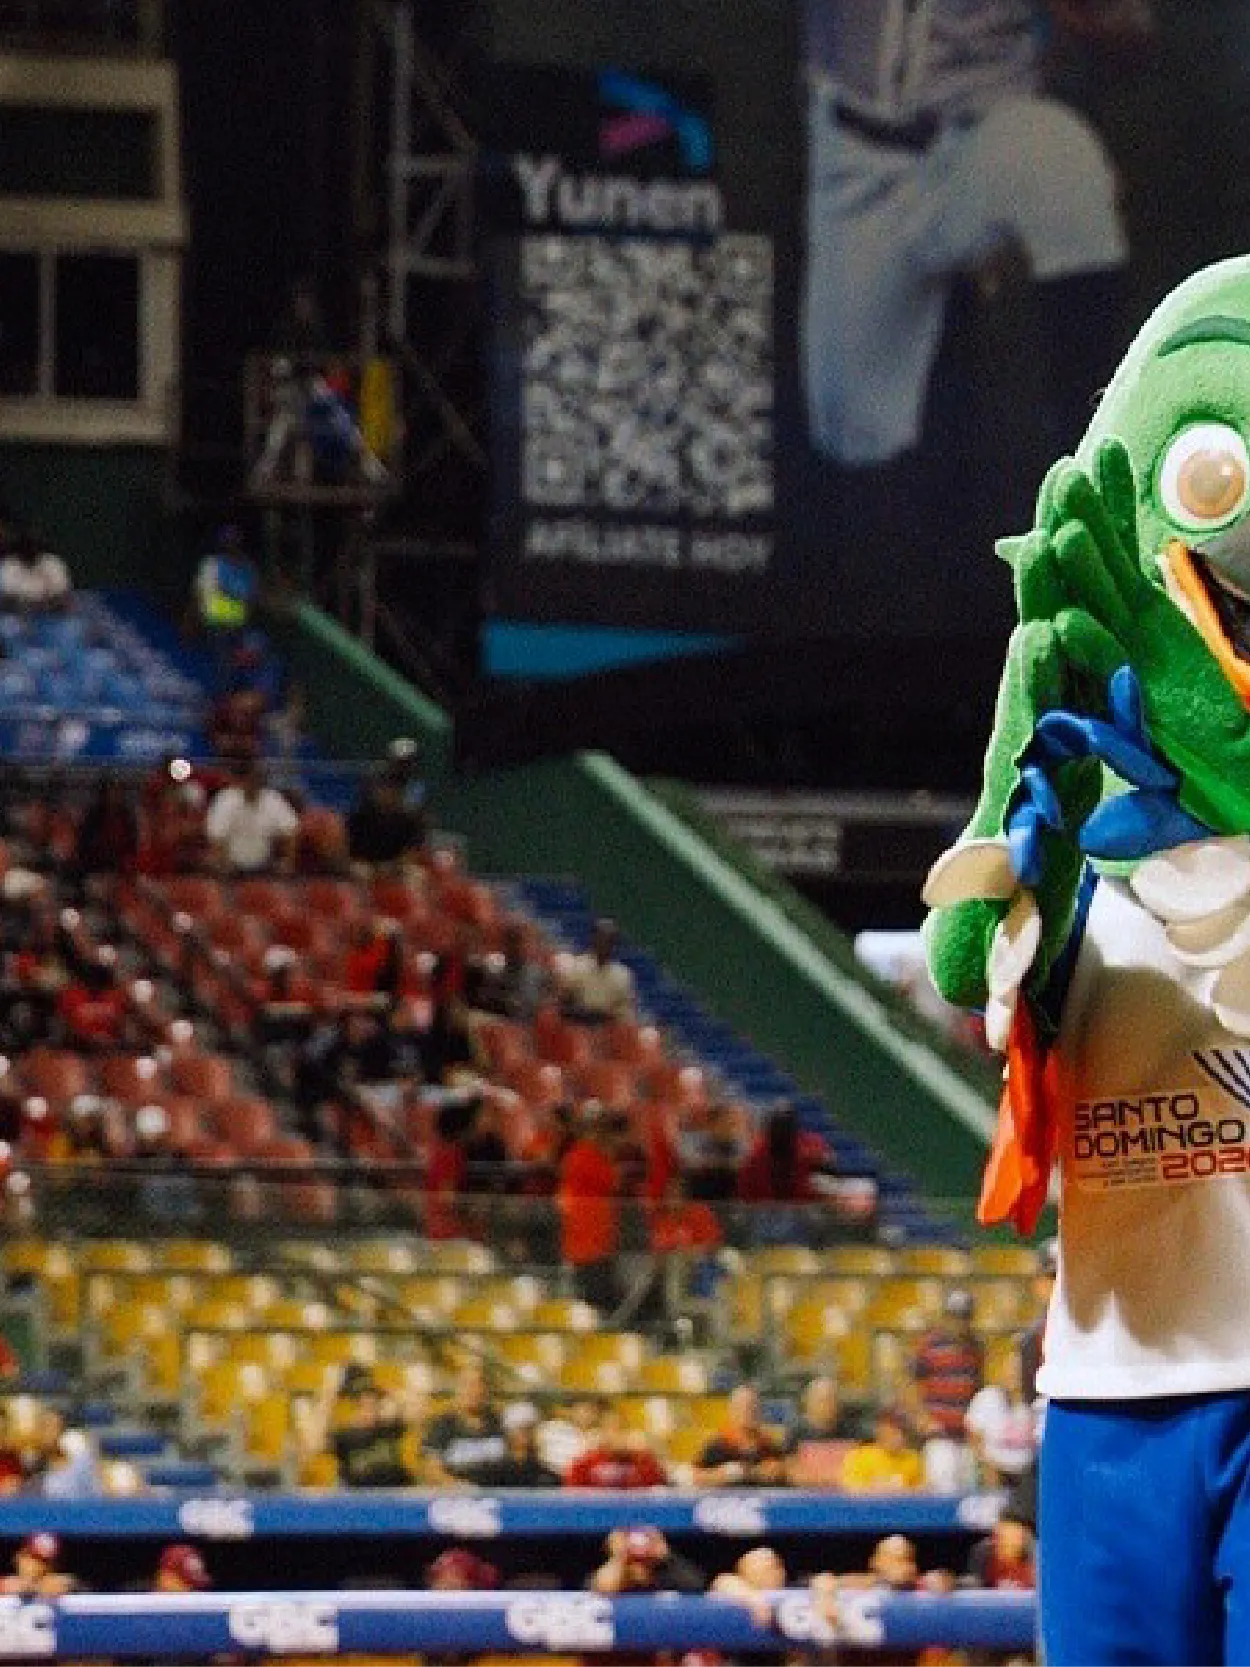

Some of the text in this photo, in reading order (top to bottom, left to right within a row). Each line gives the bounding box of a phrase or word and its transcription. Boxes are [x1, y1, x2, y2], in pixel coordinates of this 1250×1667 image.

[512, 153, 721, 230] Yunen
[1074, 1094, 1199, 1131] SANTO
[1074, 1119, 1245, 1159] DOMINGO
